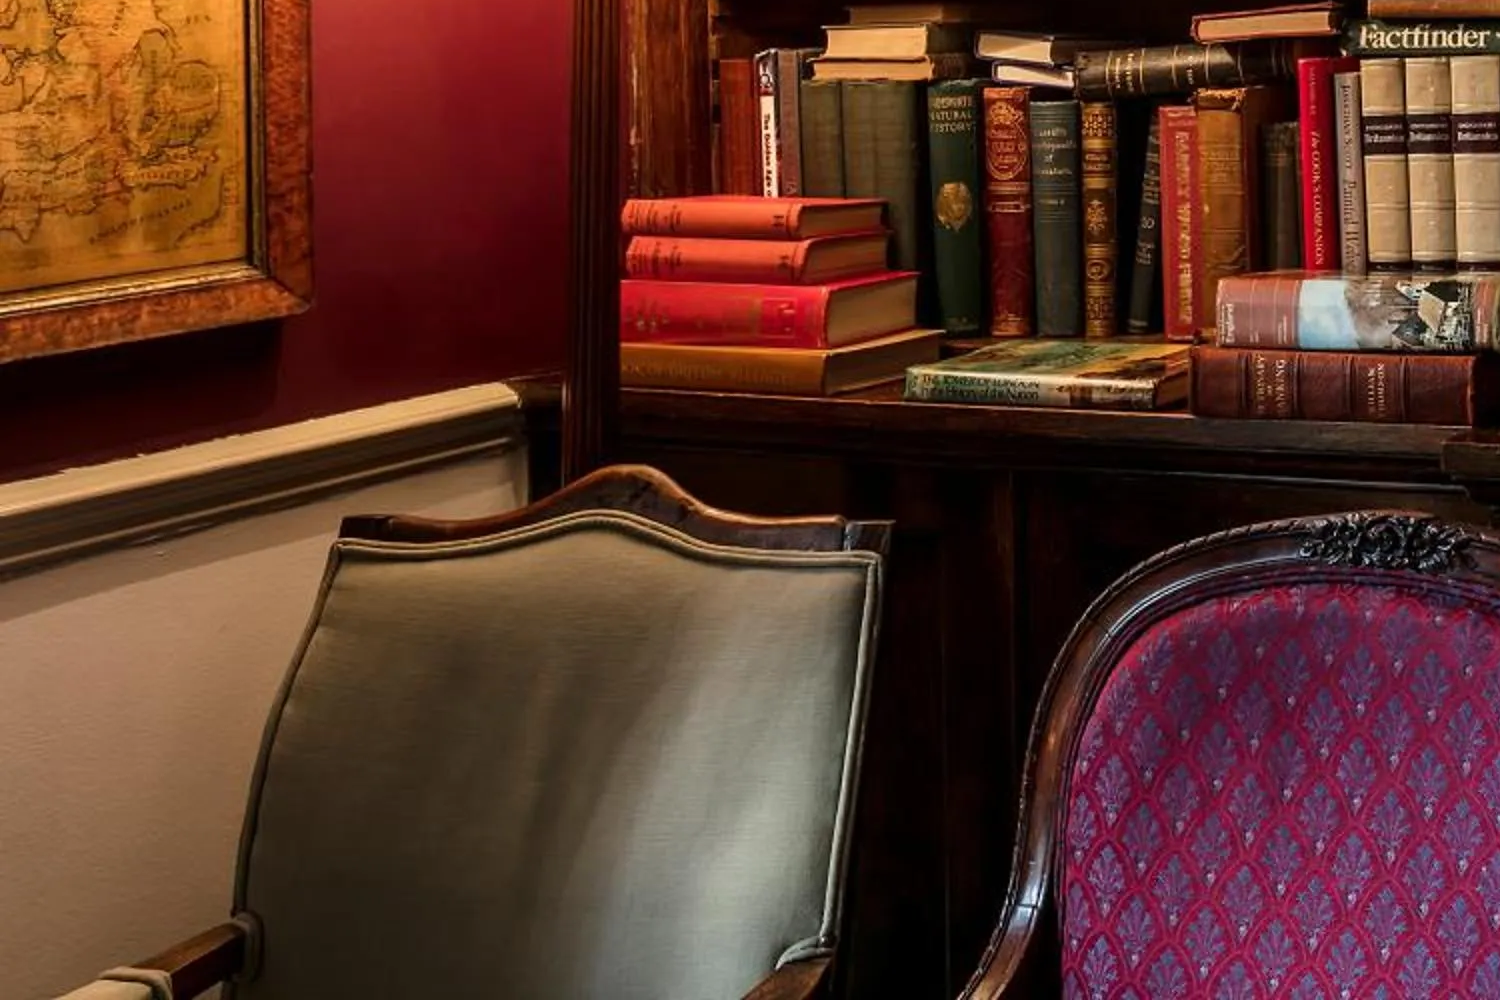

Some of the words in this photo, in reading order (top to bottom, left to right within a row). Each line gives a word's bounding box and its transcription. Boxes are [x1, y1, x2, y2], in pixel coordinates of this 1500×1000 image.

[1359, 23, 1491, 49] Factfinder
[763, 113, 771, 131] The
[1343, 179, 1357, 225] Painted
[1312, 195, 1324, 265] COMPANION
[1226, 303, 1236, 343] England
